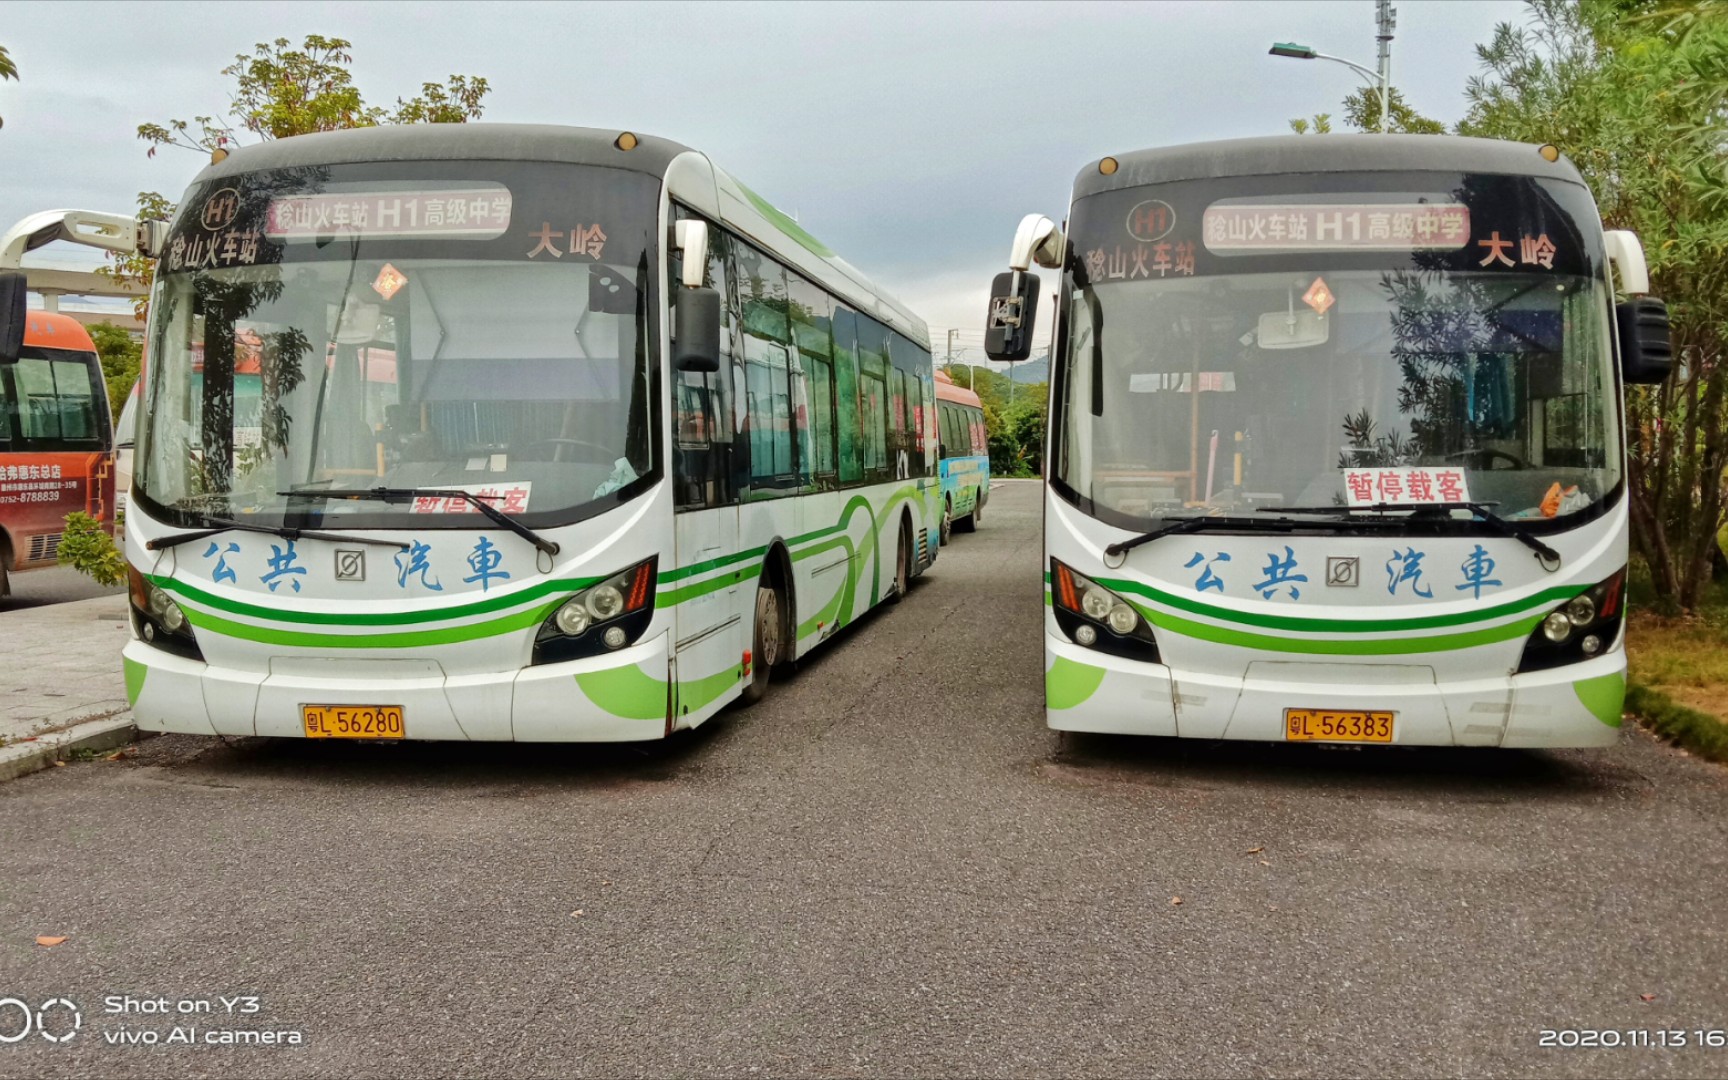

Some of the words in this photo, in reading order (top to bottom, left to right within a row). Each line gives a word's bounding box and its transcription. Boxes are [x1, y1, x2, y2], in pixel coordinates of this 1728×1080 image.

[205, 193, 236, 224] H1
[275, 202, 368, 229] 稔山火车站
[377, 199, 418, 228] H1
[425, 196, 512, 226] 高级中学
[1134, 206, 1167, 235] H1
[1208, 213, 1307, 241] 稔山火车站
[1316, 213, 1362, 240] H1
[1368, 212, 1464, 240] 高级中学
[168, 227, 261, 271] 稔山火车站
[526, 221, 608, 261] 大岭
[1478, 231, 1557, 270] 大岭
[1086, 240, 1196, 284] 稔山火车站
[1347, 470, 1465, 503] 暂停载客
[203, 539, 308, 593] 公共
[394, 535, 511, 593] 汽車
[1184, 545, 1308, 600] 公共
[1386, 544, 1502, 600] 汽車
